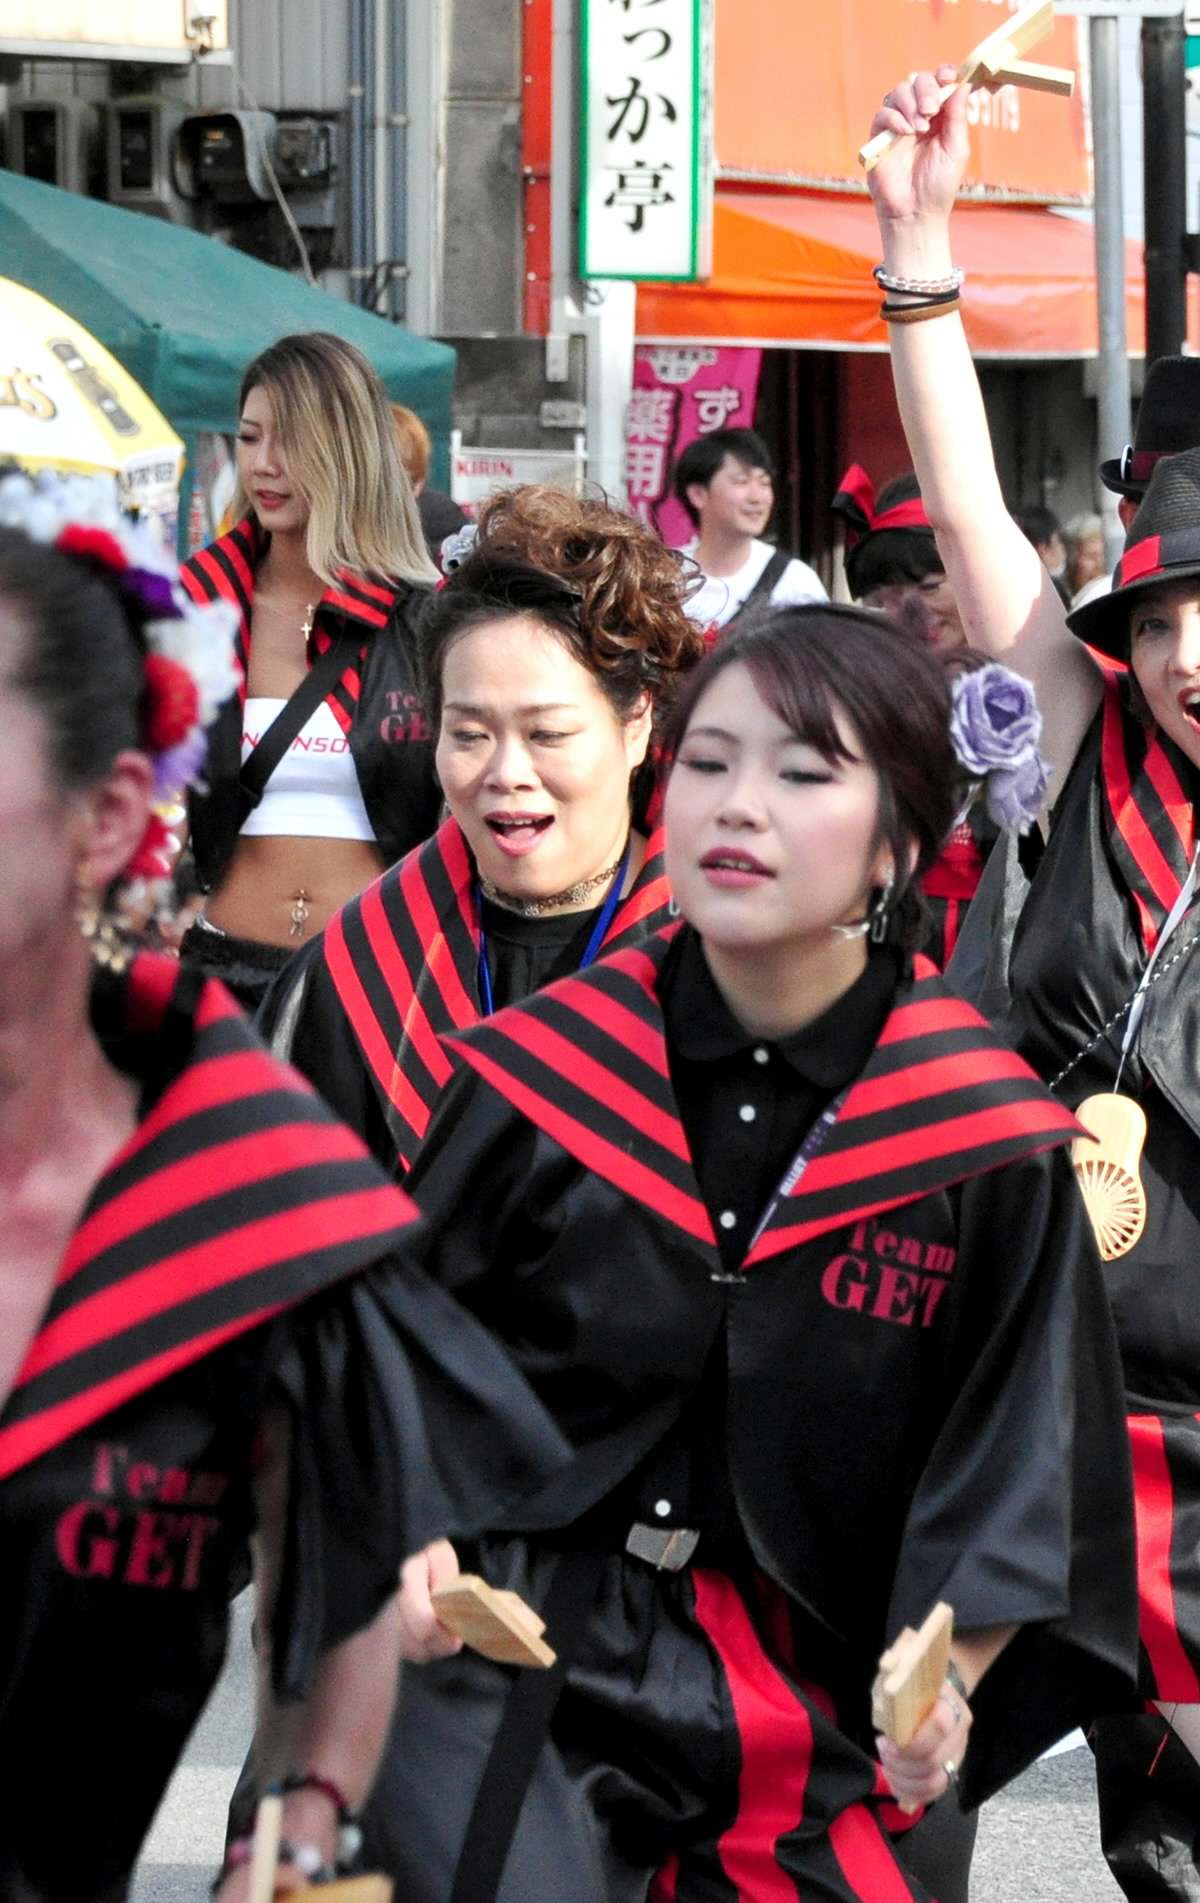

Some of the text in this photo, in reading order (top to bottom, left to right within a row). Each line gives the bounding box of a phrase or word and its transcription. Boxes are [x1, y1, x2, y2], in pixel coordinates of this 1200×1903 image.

[604, 0, 677, 233] っか亭
[456, 460, 512, 476] KIRIN
[626, 386, 675, 522] 薬用
[850, 1218, 957, 1273] Team
[820, 1253, 951, 1328] GET
[56, 1500, 220, 1590] GET
